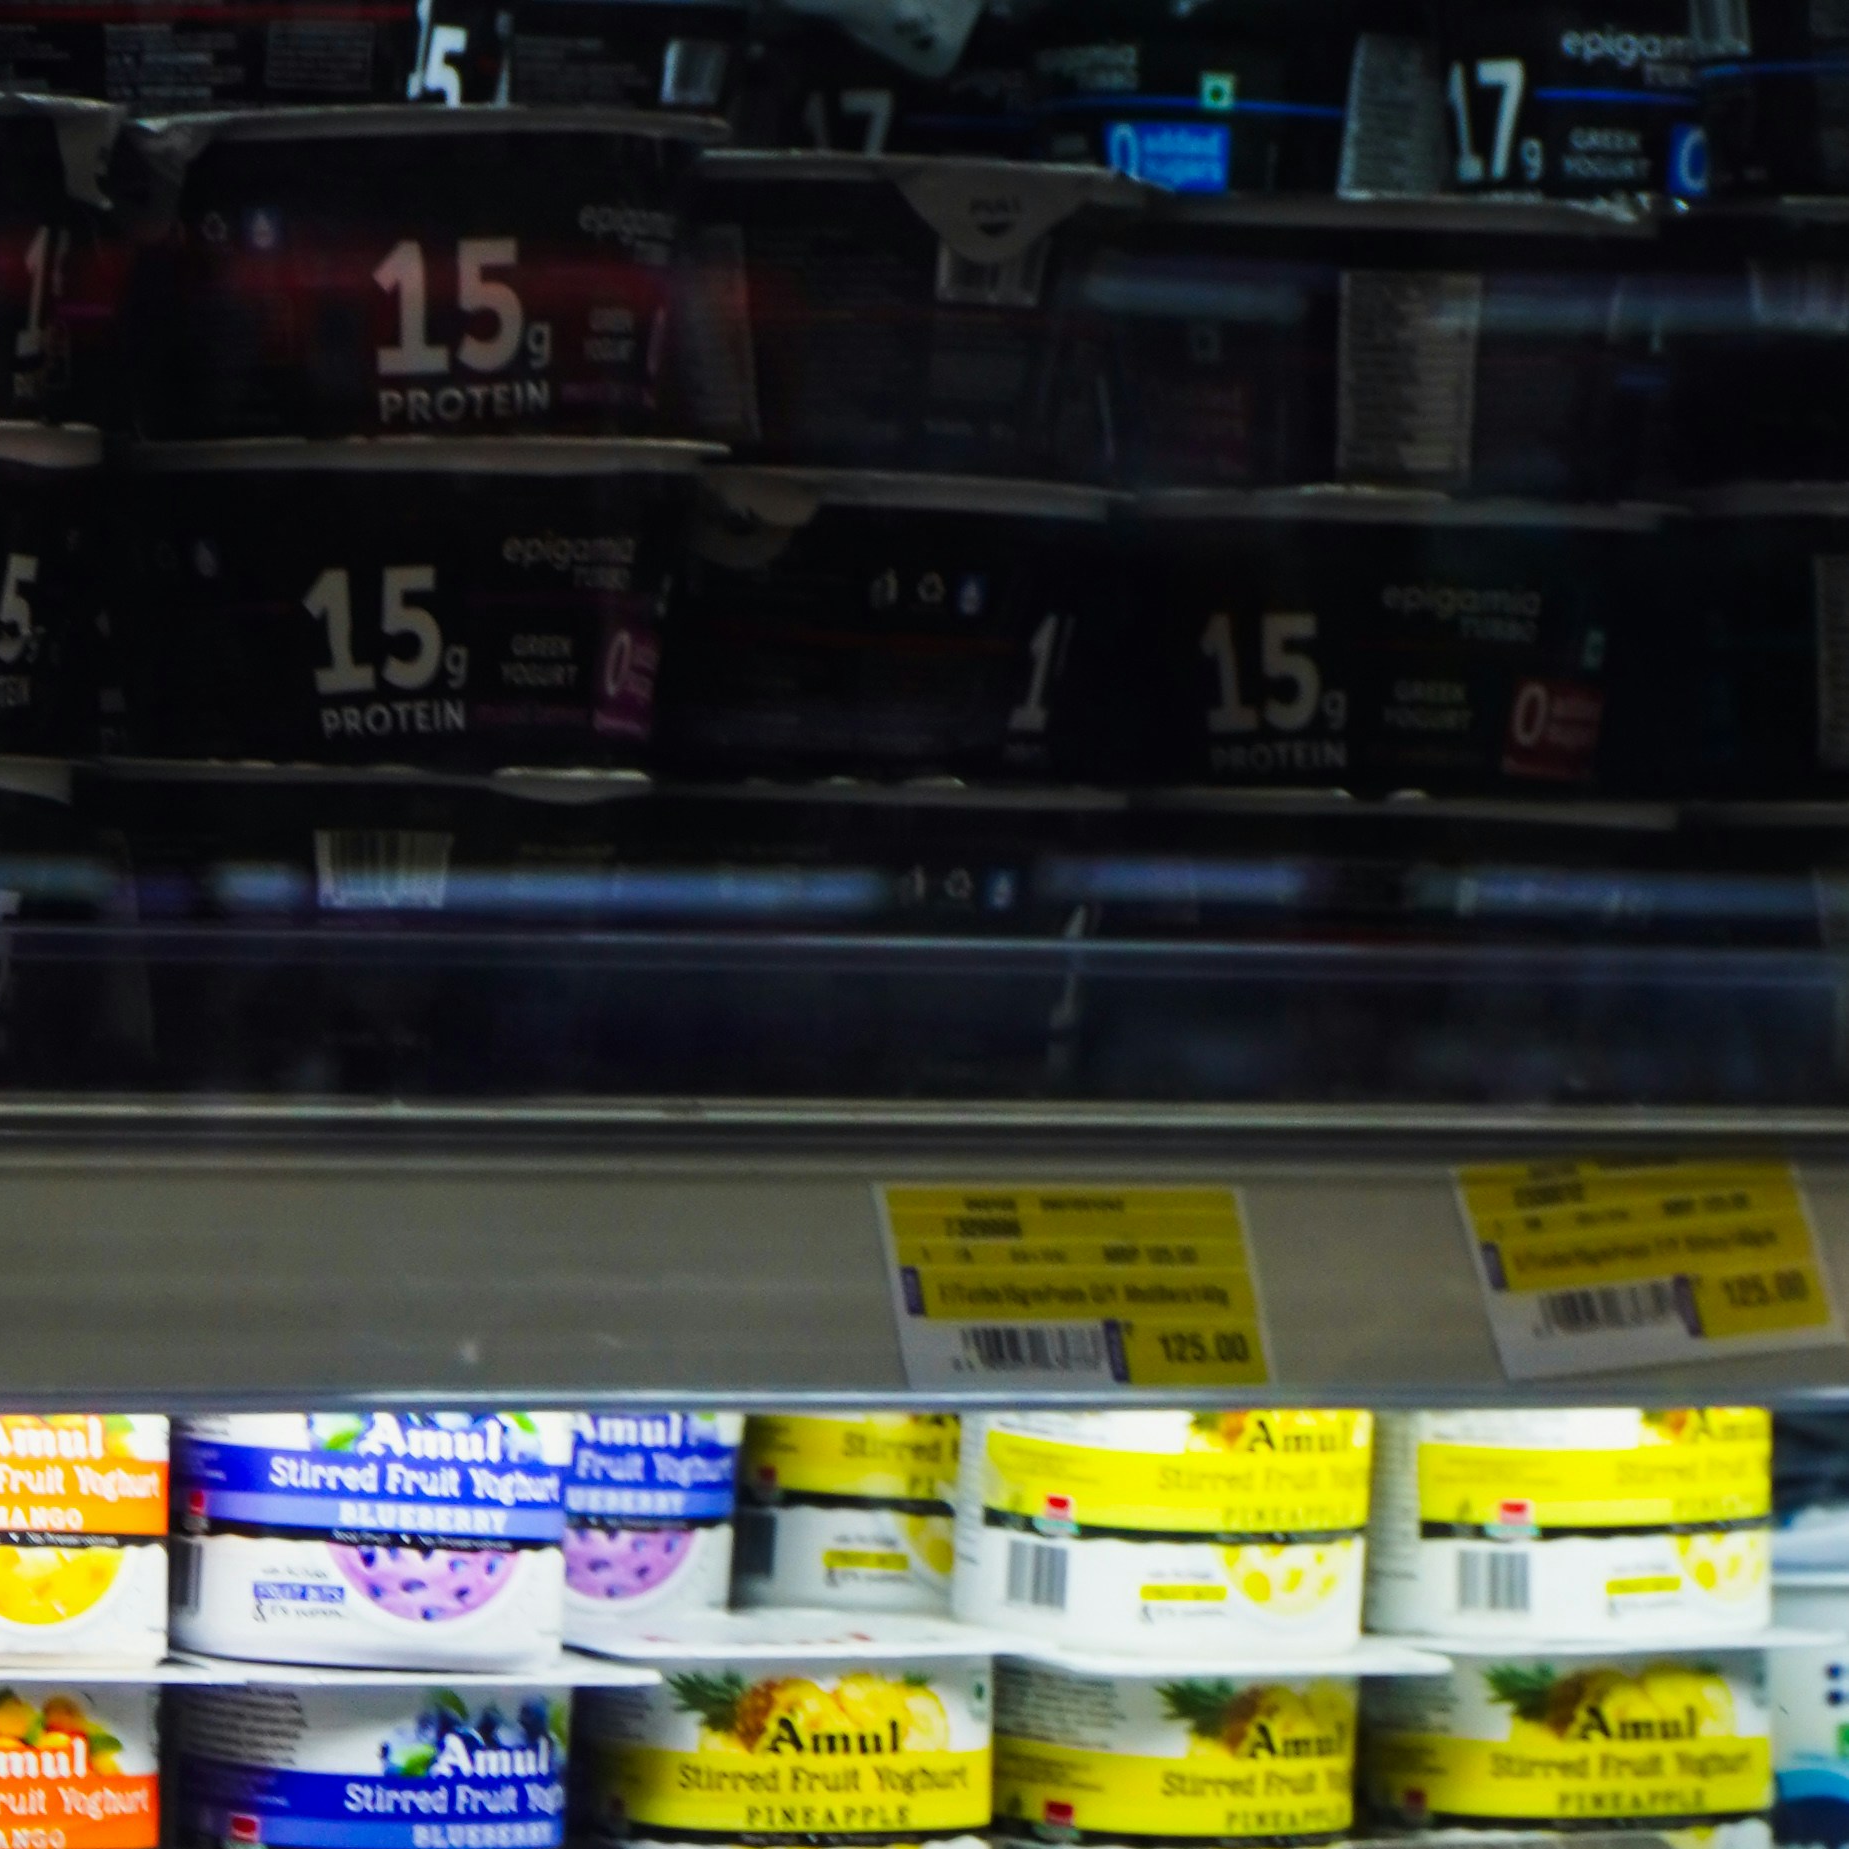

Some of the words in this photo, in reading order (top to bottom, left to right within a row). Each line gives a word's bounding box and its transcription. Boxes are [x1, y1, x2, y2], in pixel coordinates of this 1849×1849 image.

[372, 237, 552, 377] 15g
[378, 380, 552, 424] PROTEIN
[302, 564, 469, 696] 15g
[321, 699, 467, 739] PROTEIN
[1210, 740, 1347, 774] PROTEIN
[1158, 1331, 1250, 1363] 125.00
[358, 1416, 502, 1463] Amul
[269, 1456, 379, 1495] Stirred
[385, 1461, 463, 1498] Fruit
[337, 1502, 509, 1534] BLUEBERRY
[763, 1719, 902, 1757] Amul
[1578, 1706, 1697, 1742] Amul
[432, 1732, 548, 1779] Amul
[678, 1765, 779, 1792] Stirred
[788, 1765, 861, 1793] Fruit
[874, 1765, 969, 1797] Yoghurt
[57, 1786, 149, 1822] Yoghurt
[344, 1783, 449, 1815] Stirred
[455, 1785, 523, 1816] Fruit
[745, 1805, 911, 1827] PINEAPPLE
[1558, 1792, 1706, 1812] PINEAPPLE
